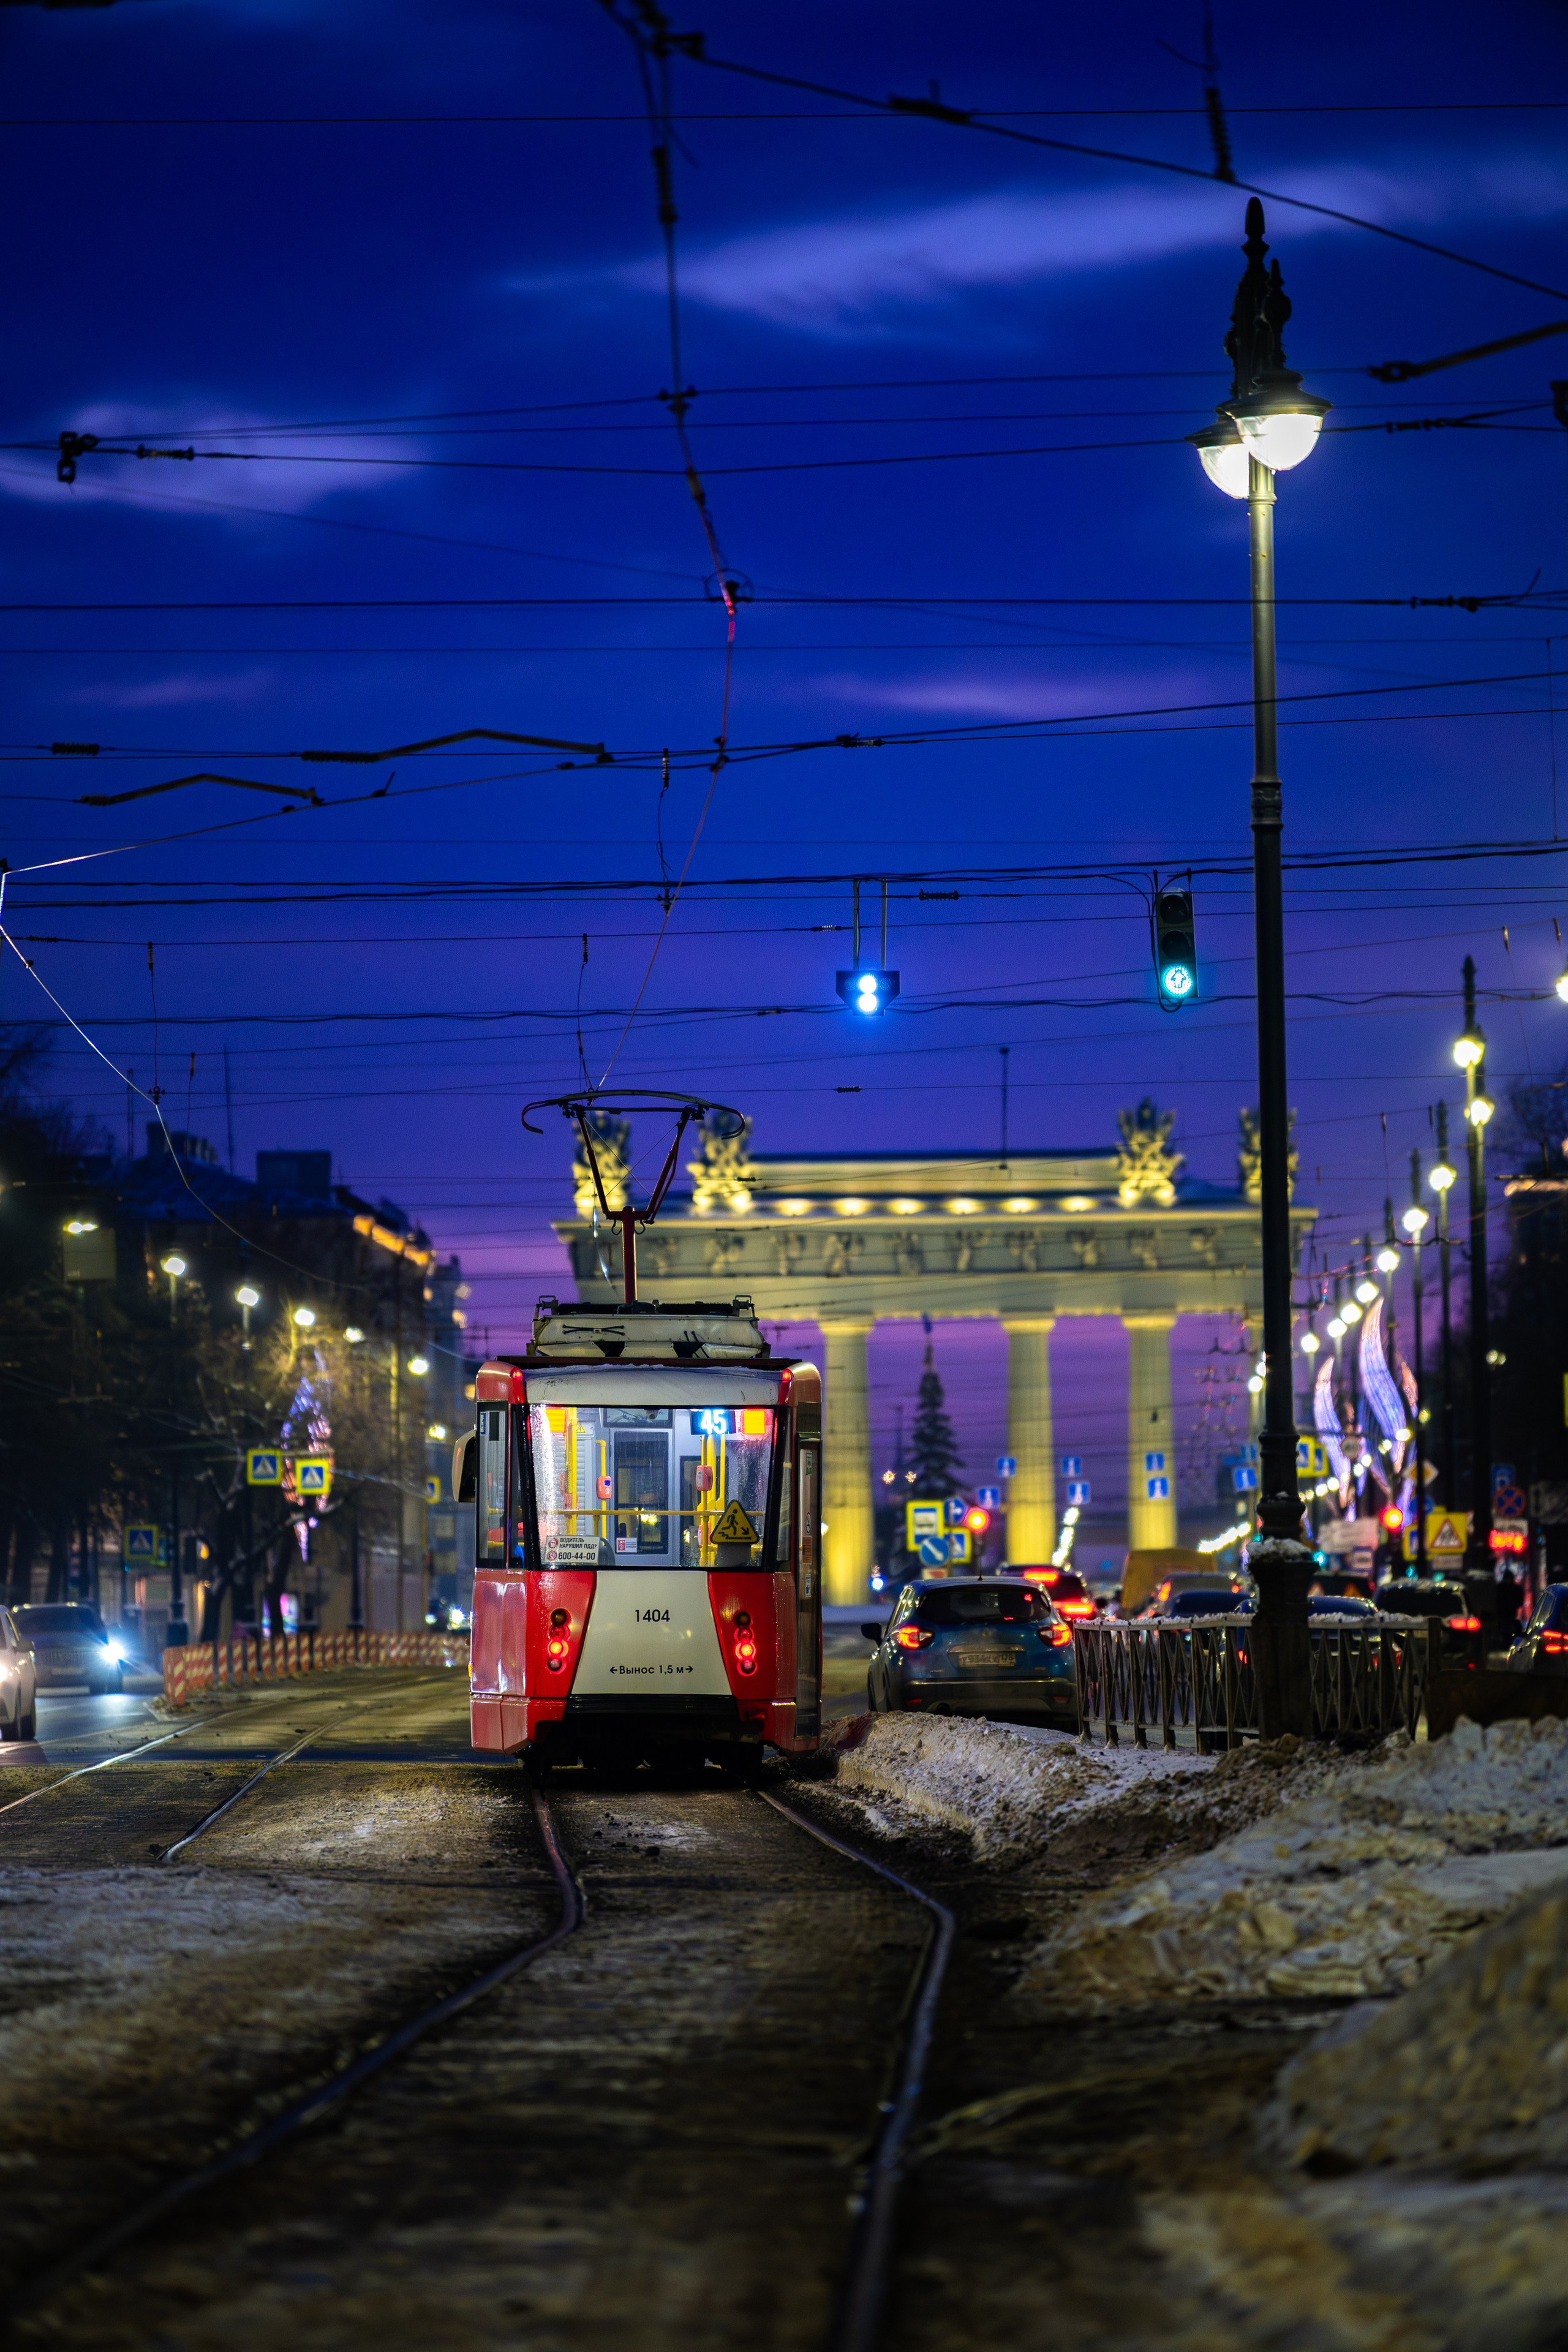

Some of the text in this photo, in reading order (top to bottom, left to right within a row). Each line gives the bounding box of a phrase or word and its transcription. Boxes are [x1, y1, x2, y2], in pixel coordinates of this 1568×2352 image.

[701, 1409, 726, 1434] 45
[558, 1551, 595, 1560] 600-44-00
[635, 1609, 670, 1622] 1404
[619, 1665, 655, 1674] Вынос
[659, 1665, 673, 1675] 1,5
